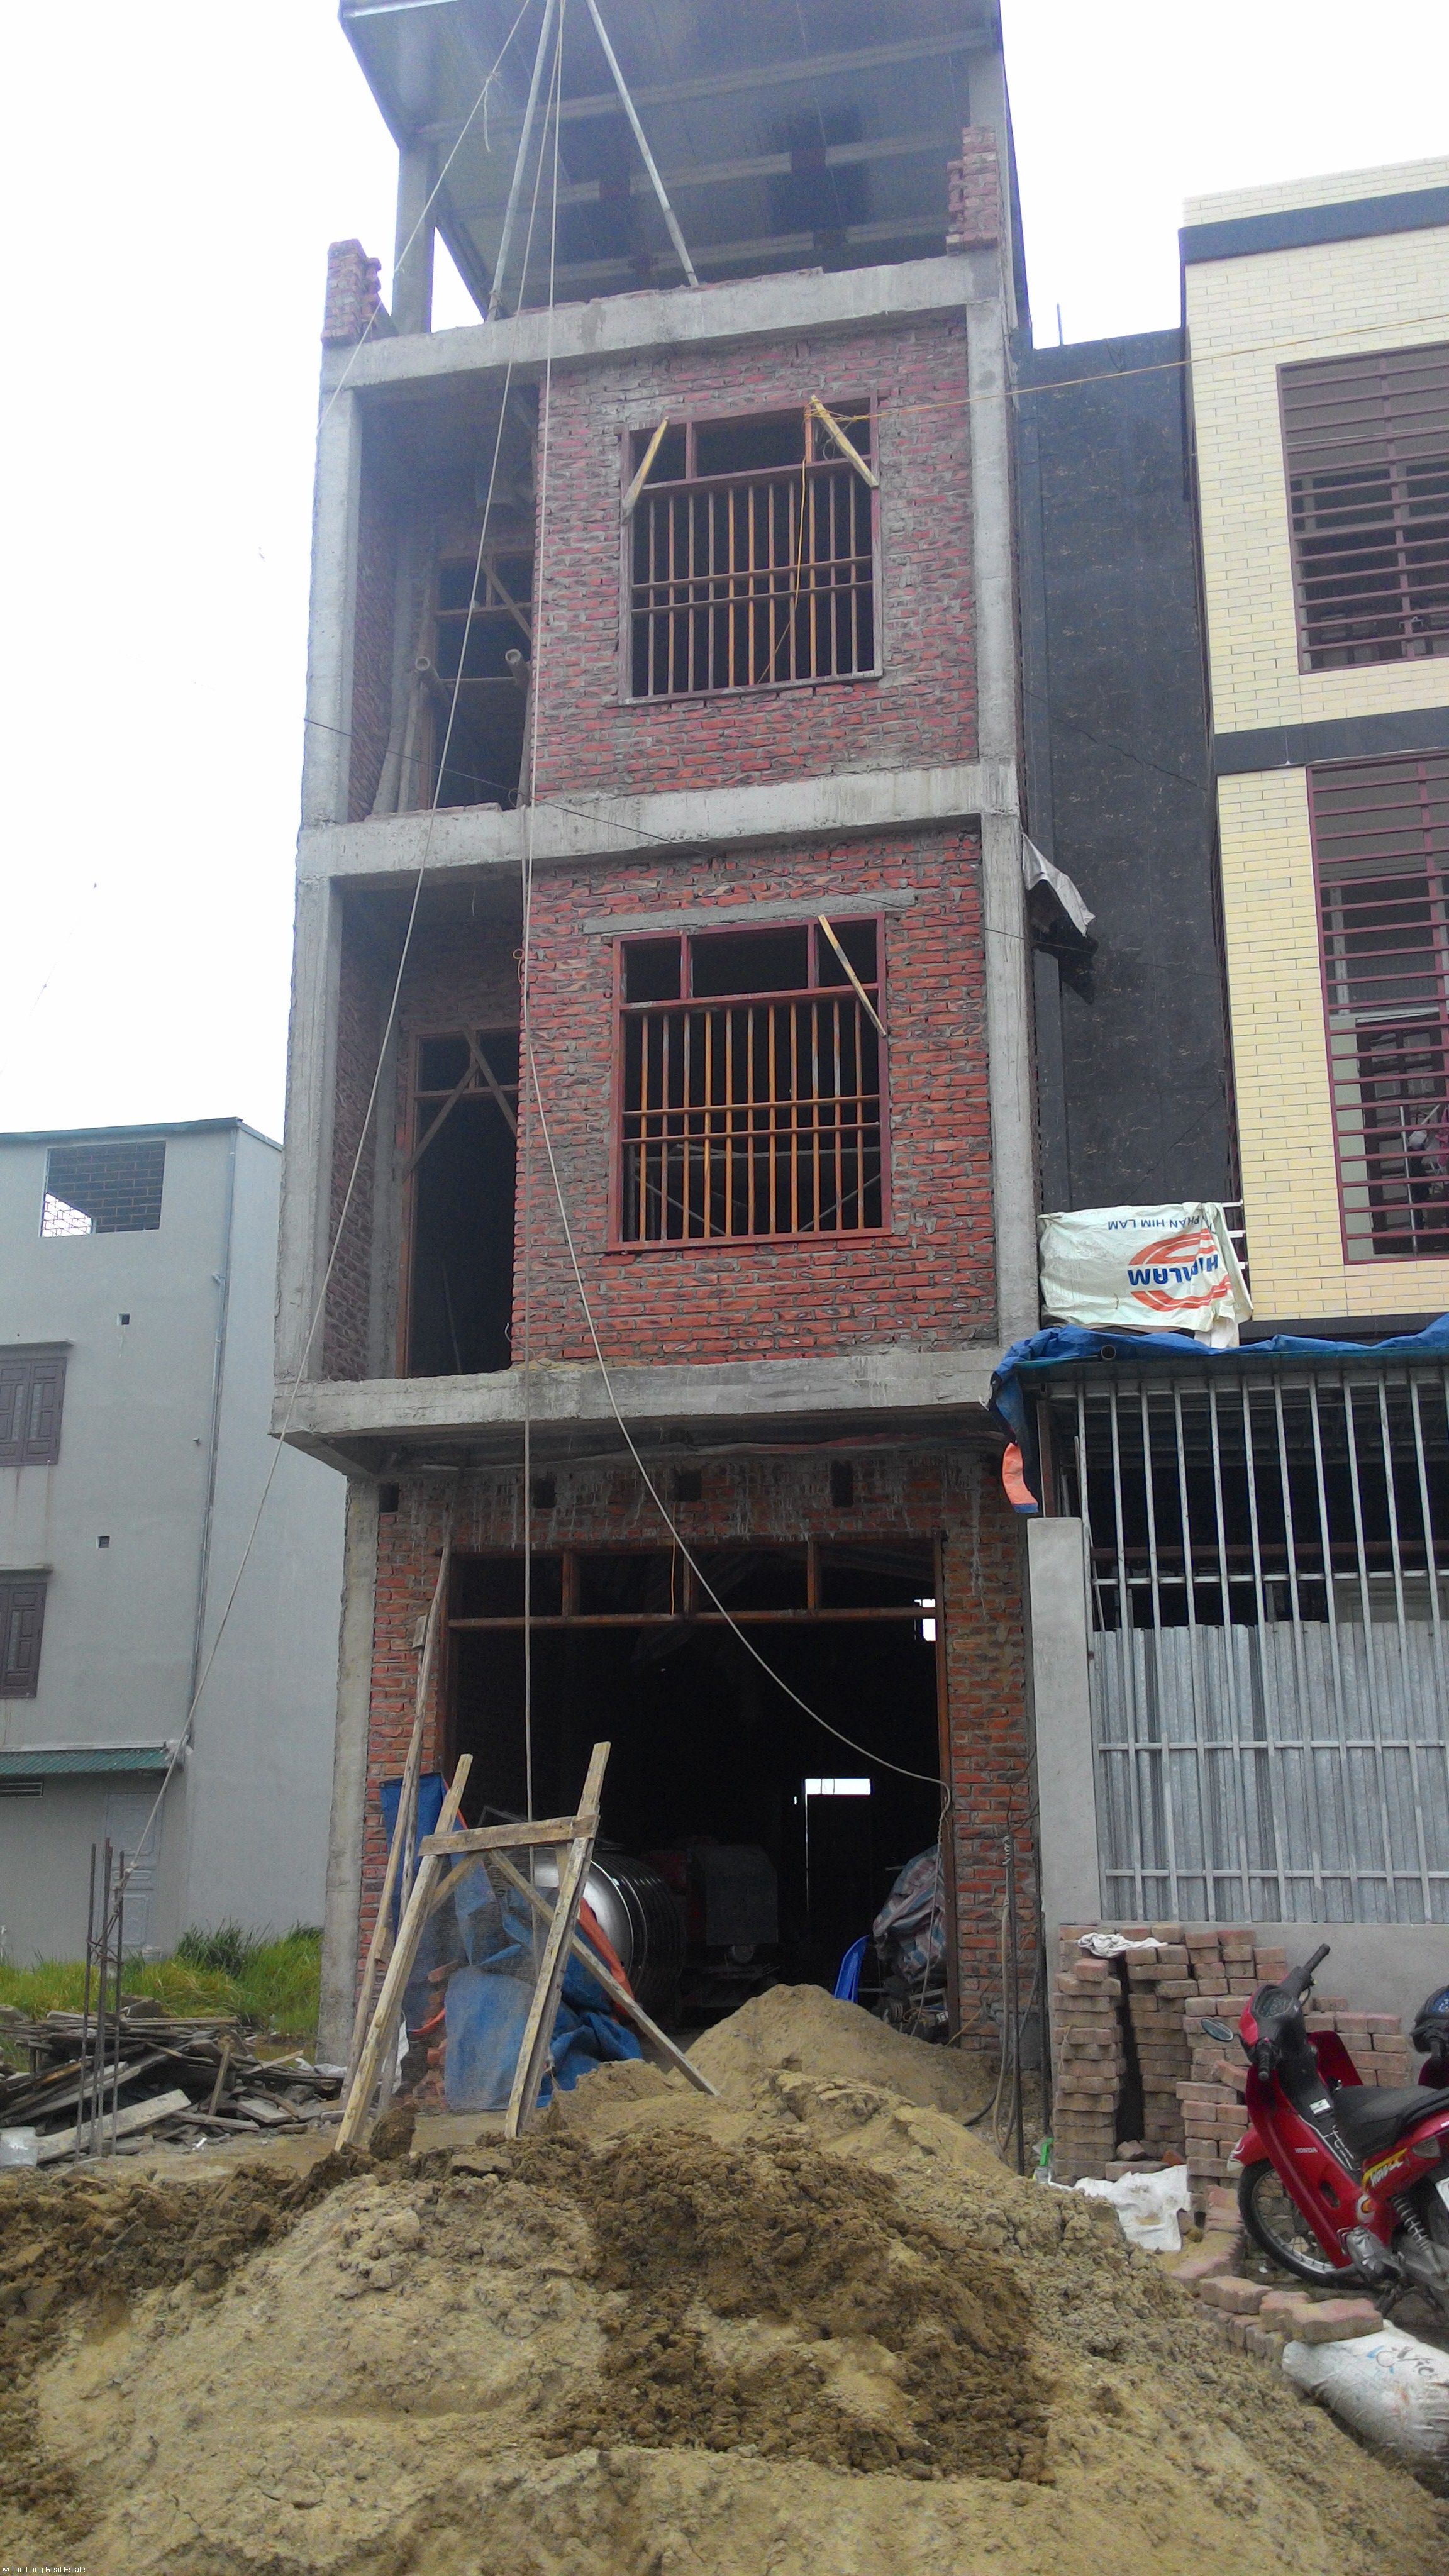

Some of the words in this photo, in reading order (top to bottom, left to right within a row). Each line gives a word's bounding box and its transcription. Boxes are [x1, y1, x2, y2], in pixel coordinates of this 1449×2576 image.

[1108, 1219, 1136, 1230] LAM
[1141, 1219, 1165, 1228] HIM
[1127, 1253, 1218, 1286] HIMLAM
